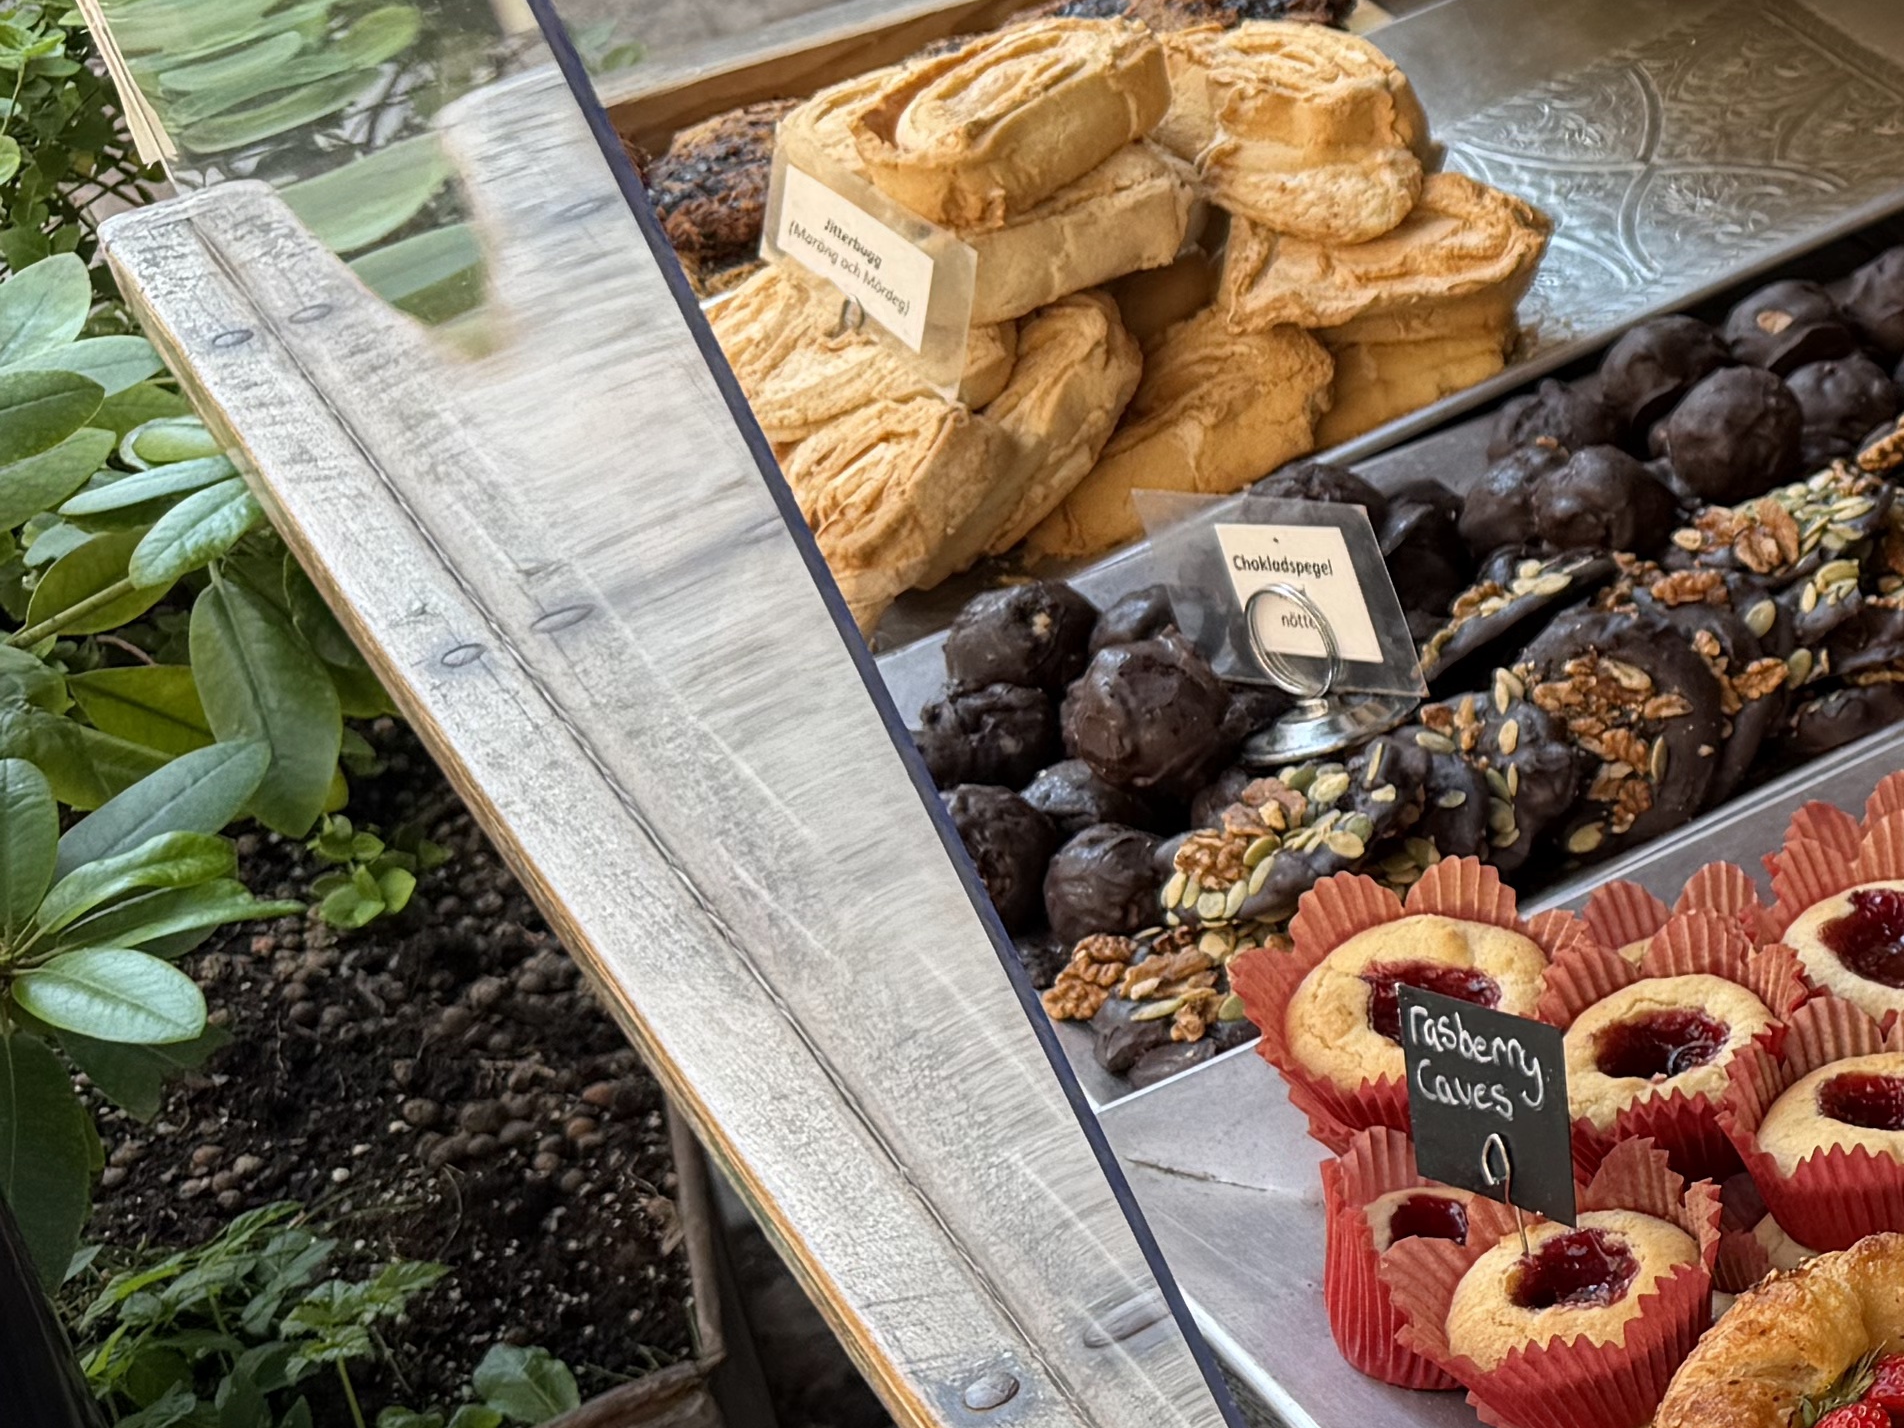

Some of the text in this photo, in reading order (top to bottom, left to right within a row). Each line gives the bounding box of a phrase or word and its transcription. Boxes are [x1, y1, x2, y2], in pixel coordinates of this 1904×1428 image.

[823, 217, 883, 270] Jitterbugg
[840, 256, 861, 279] och
[1232, 554, 1334, 579] Chokladspegel
[1281, 611, 1319, 630] nötte
